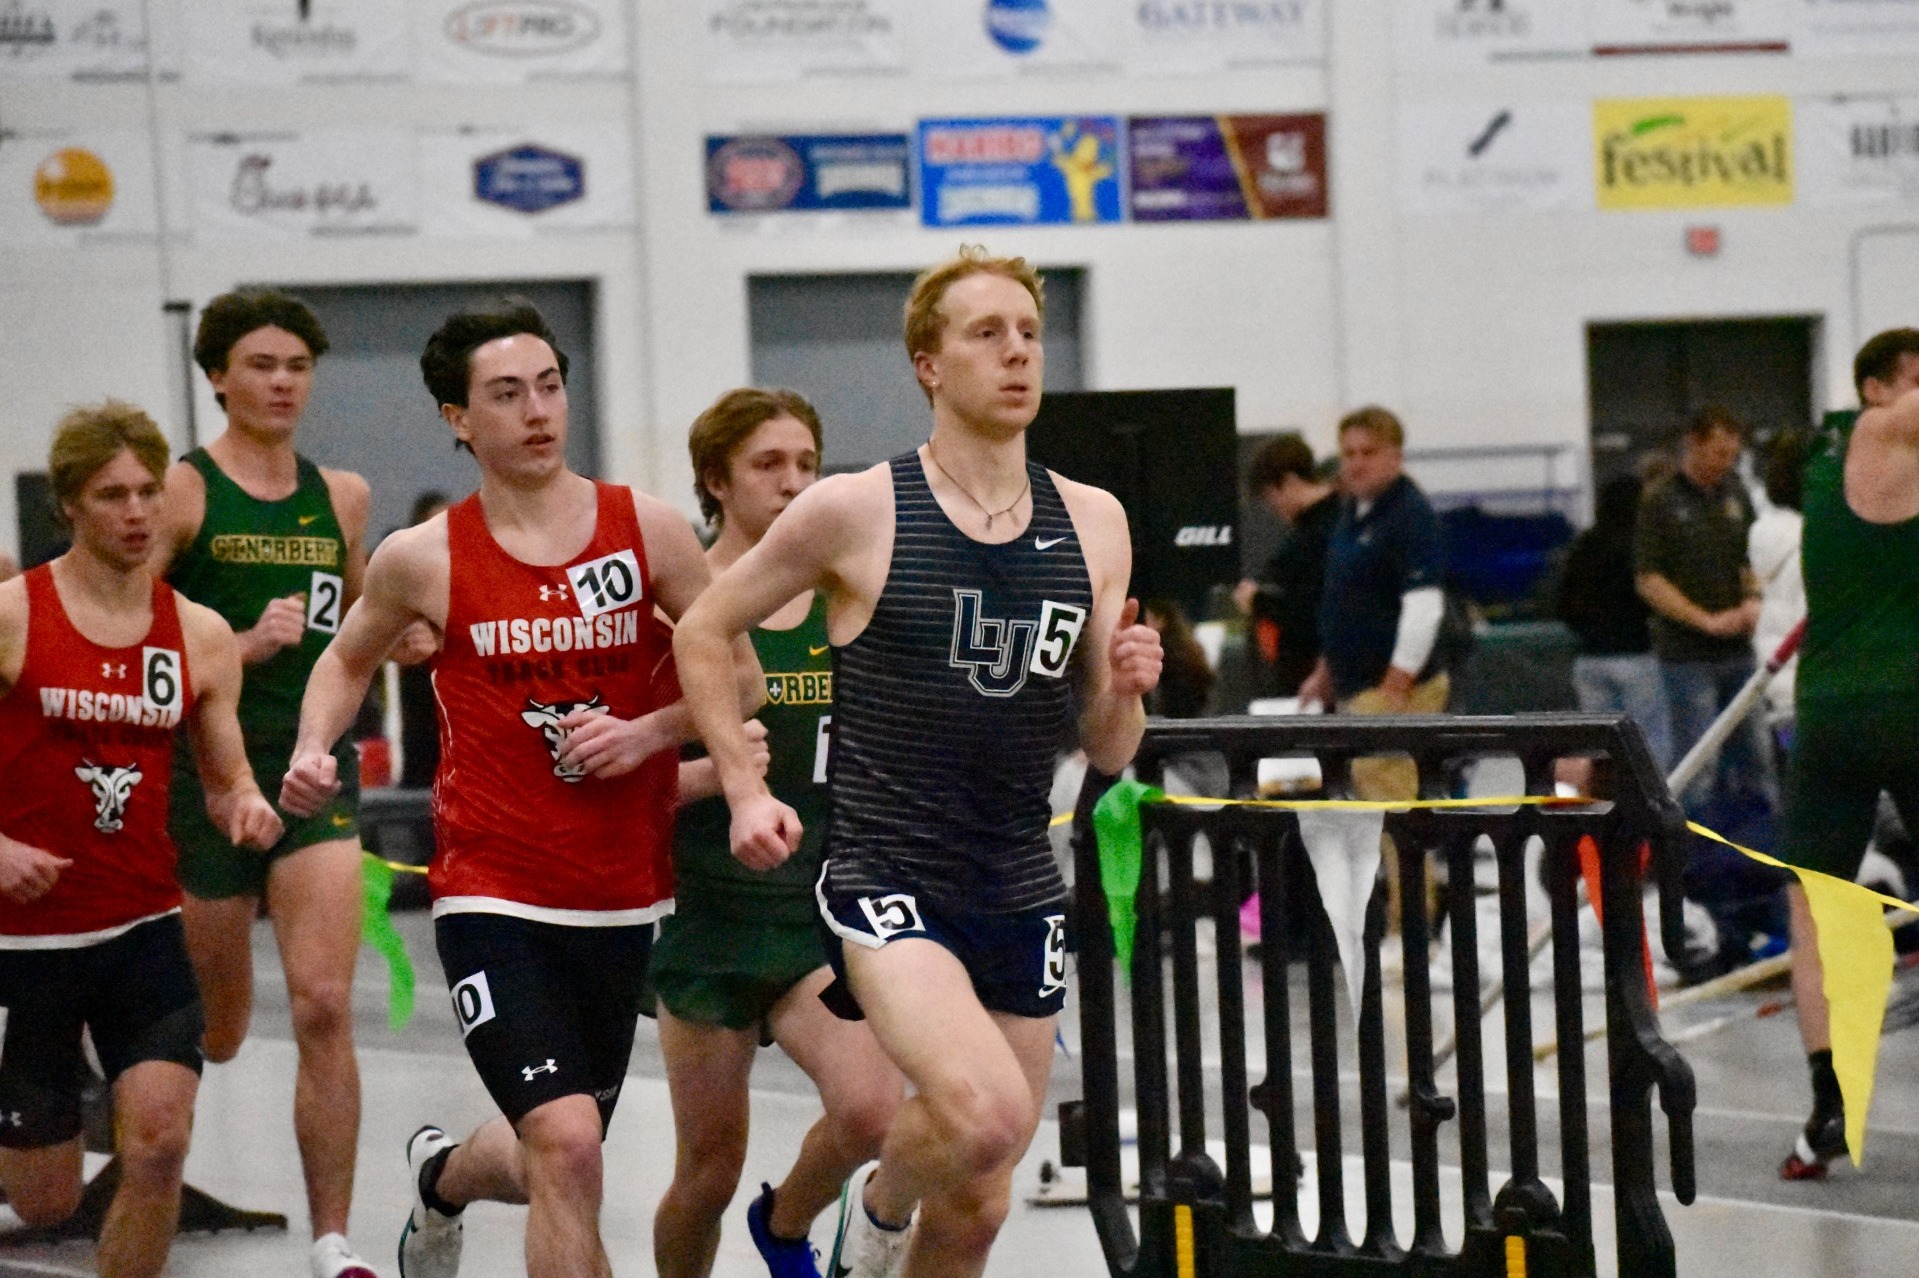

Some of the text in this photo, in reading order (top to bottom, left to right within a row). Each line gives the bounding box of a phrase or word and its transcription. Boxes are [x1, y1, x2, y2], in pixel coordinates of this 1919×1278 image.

[313, 581, 337, 627] 2
[576, 559, 634, 608] 10
[469, 609, 639, 657] WISCONSIN
[1039, 606, 1079, 672] 5
[147, 652, 176, 706] 6
[869, 899, 916, 931] 5
[1049, 918, 1066, 983] 5
